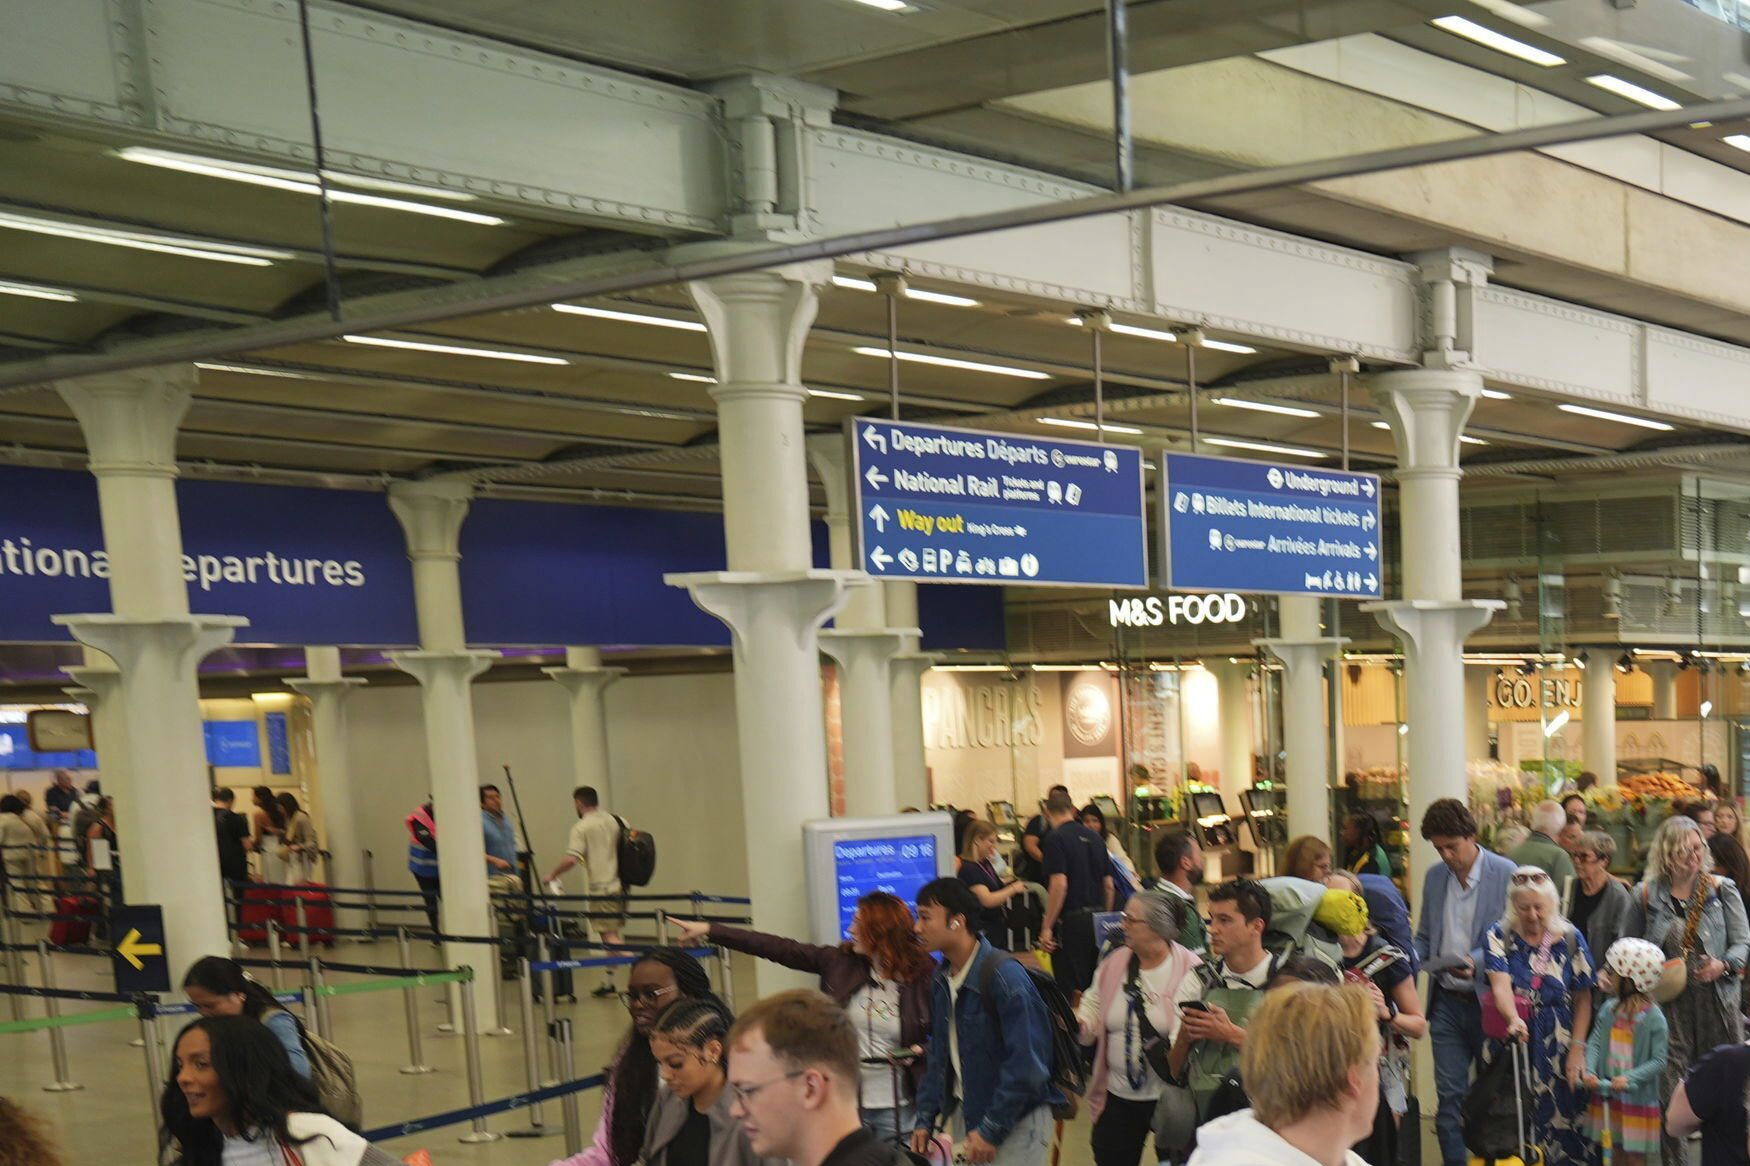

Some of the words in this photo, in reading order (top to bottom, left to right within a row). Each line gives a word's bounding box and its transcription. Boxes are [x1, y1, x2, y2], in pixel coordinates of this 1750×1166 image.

[891, 429, 985, 459] Departures
[986, 439, 1049, 466] Départs
[894, 468, 966, 497] National
[967, 474, 1000, 498] Rail
[1285, 471, 1359, 497] Underground
[897, 509, 935, 537] Way
[936, 514, 965, 534] out
[1205, 495, 1247, 518] Billets
[1248, 499, 1323, 524] International
[1323, 507, 1360, 528] tickets
[1268, 535, 1317, 557] Arrivées
[1317, 538, 1361, 559] Arrivals
[180, 550, 366, 591] epartures
[1110, 597, 1163, 627] M&S
[1169, 593, 1246, 624] FOOD
[1543, 678, 1583, 708] ENJ
